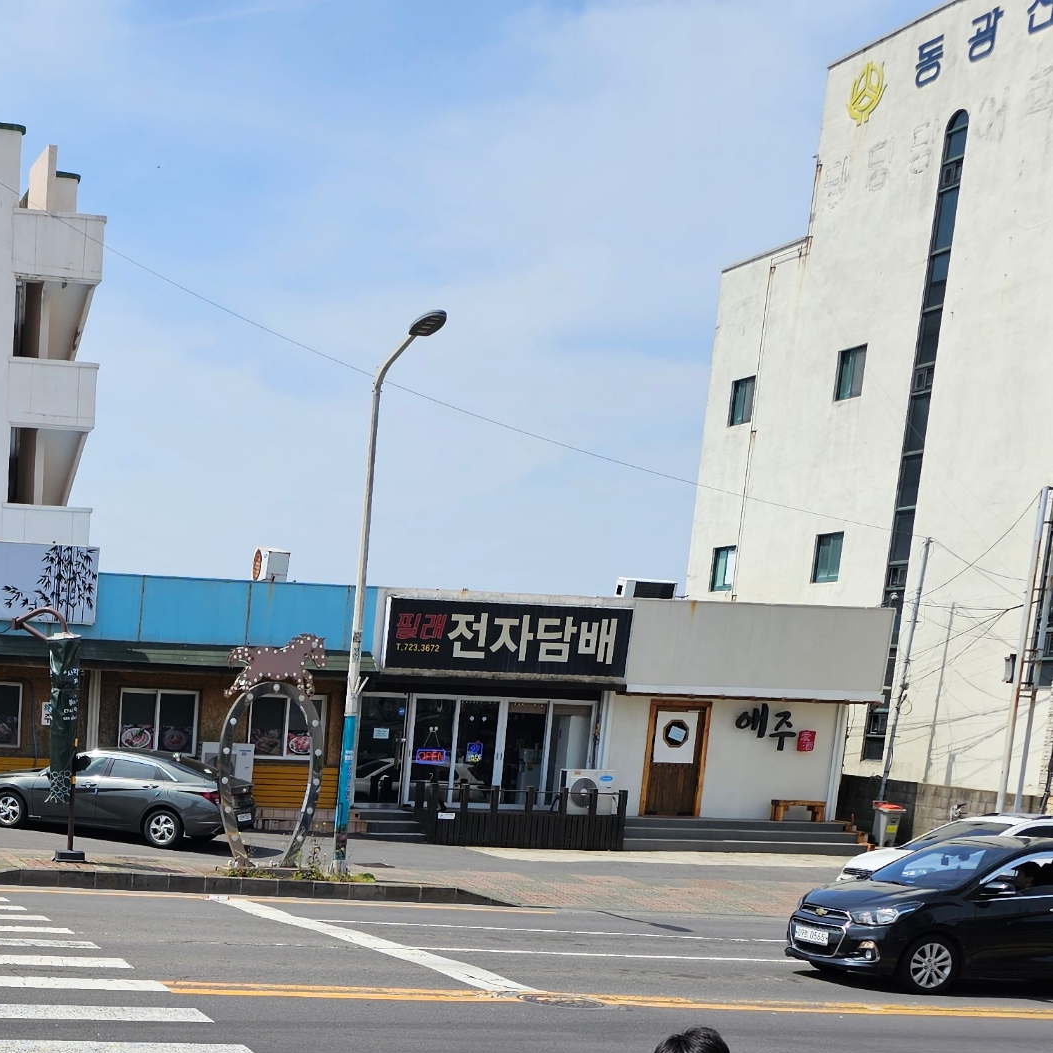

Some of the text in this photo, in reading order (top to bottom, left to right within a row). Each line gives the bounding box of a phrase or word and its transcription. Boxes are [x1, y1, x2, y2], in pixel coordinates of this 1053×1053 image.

[396, 642, 440, 652] T.723.3672
[447, 612, 618, 665] 전자담배
[735, 703, 797, 751] 애주
[418, 751, 444, 761] OPEN
